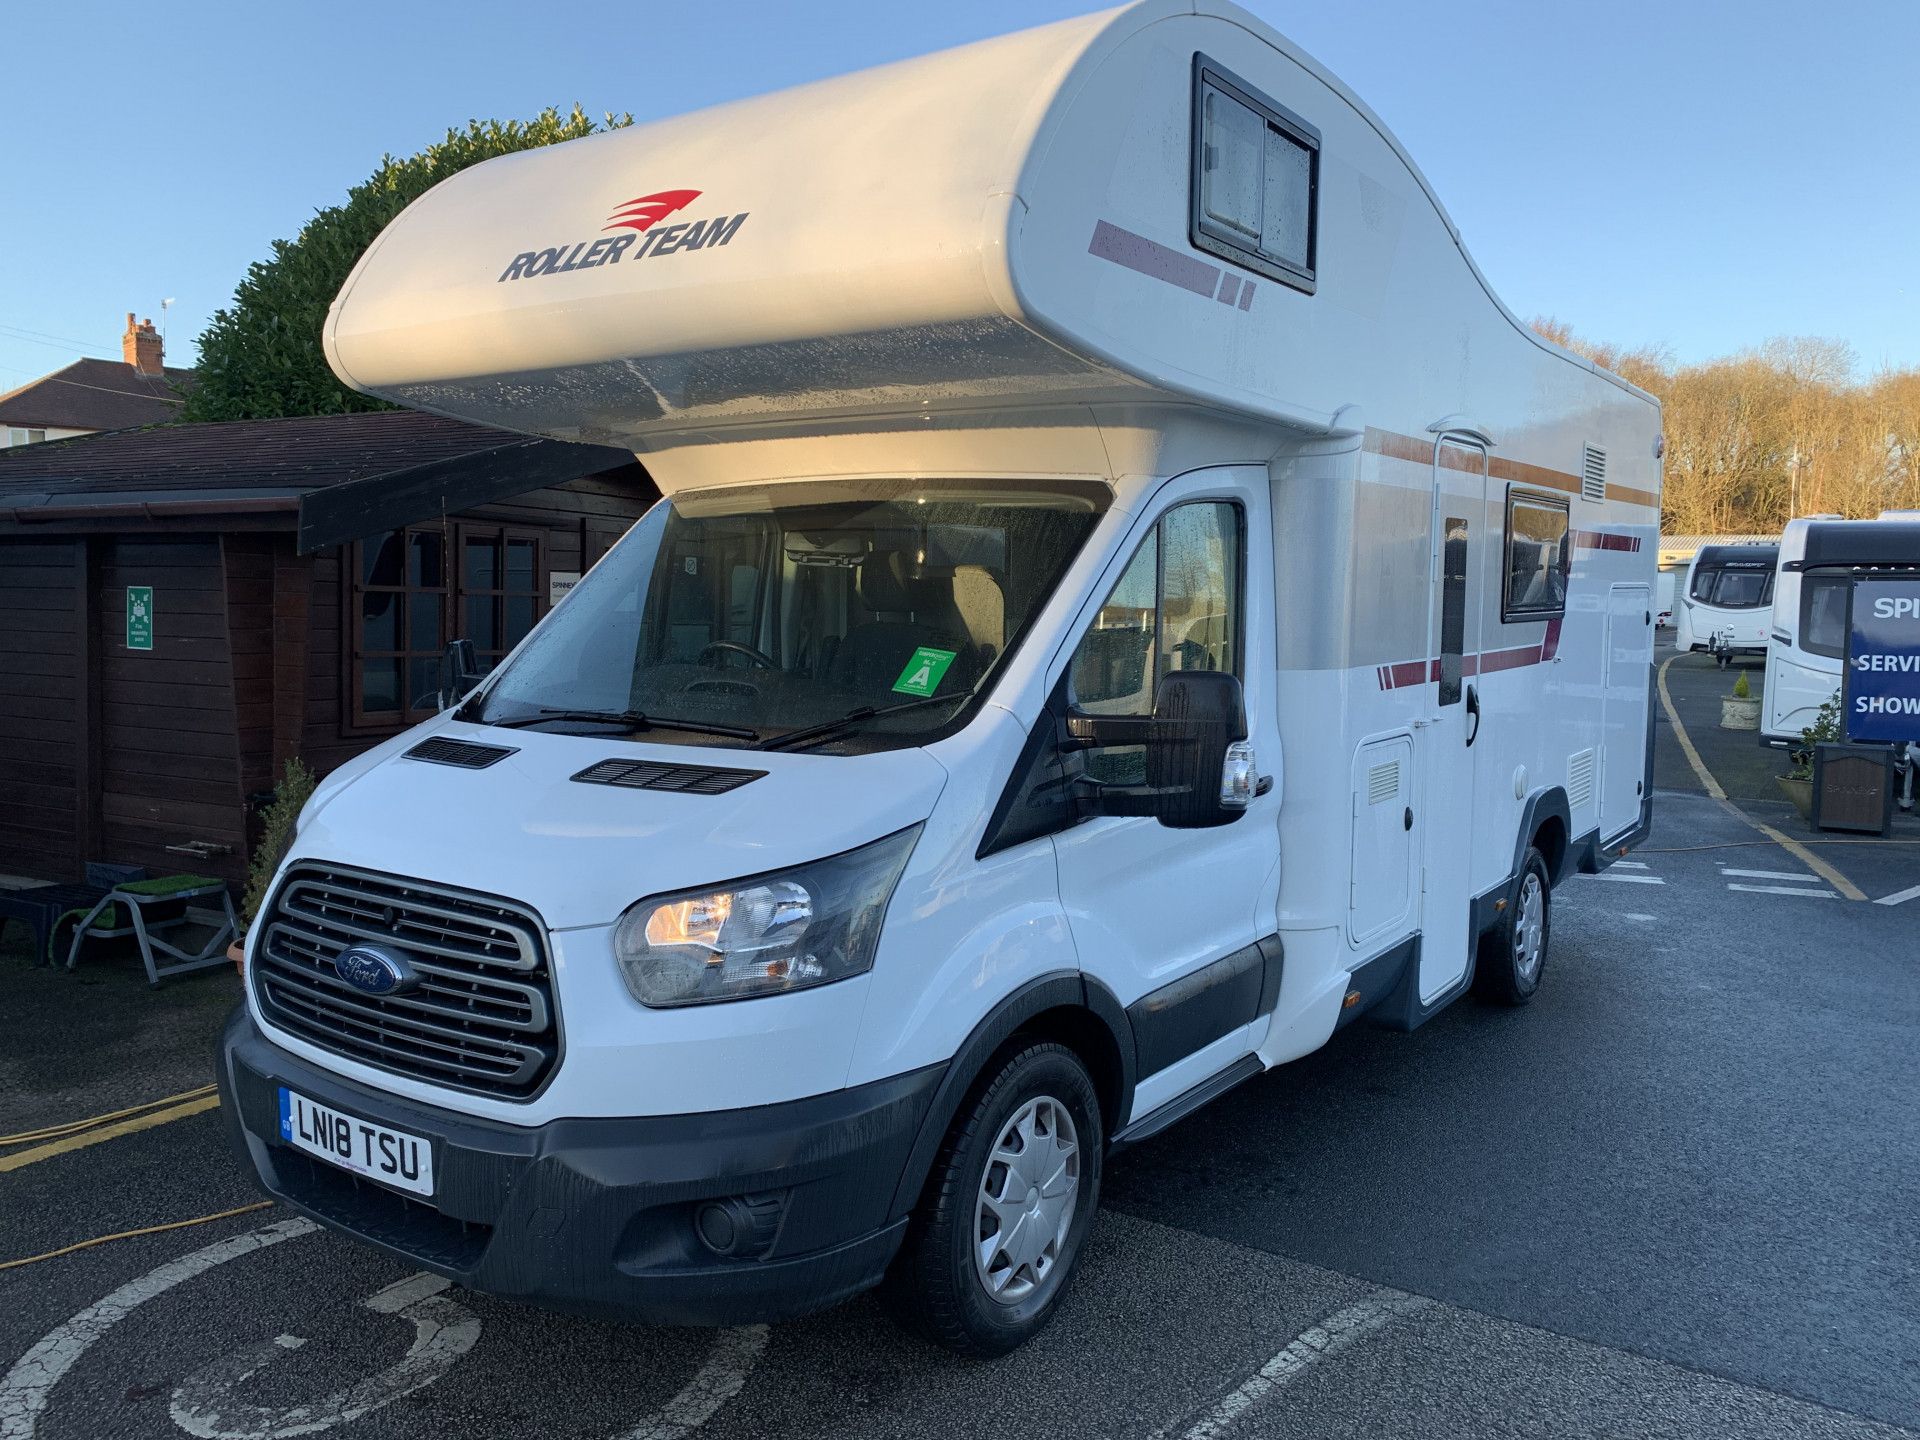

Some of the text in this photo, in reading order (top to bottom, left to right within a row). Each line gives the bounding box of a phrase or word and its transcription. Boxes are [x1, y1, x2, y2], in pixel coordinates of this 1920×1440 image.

[497, 212, 750, 283] ROLLER TEAM
[1873, 597, 1920, 619] SPI
[1857, 654, 1920, 672] SERVI
[907, 666, 931, 687] A
[344, 955, 381, 986] Ford
[298, 1099, 419, 1181] LN18 TSU
